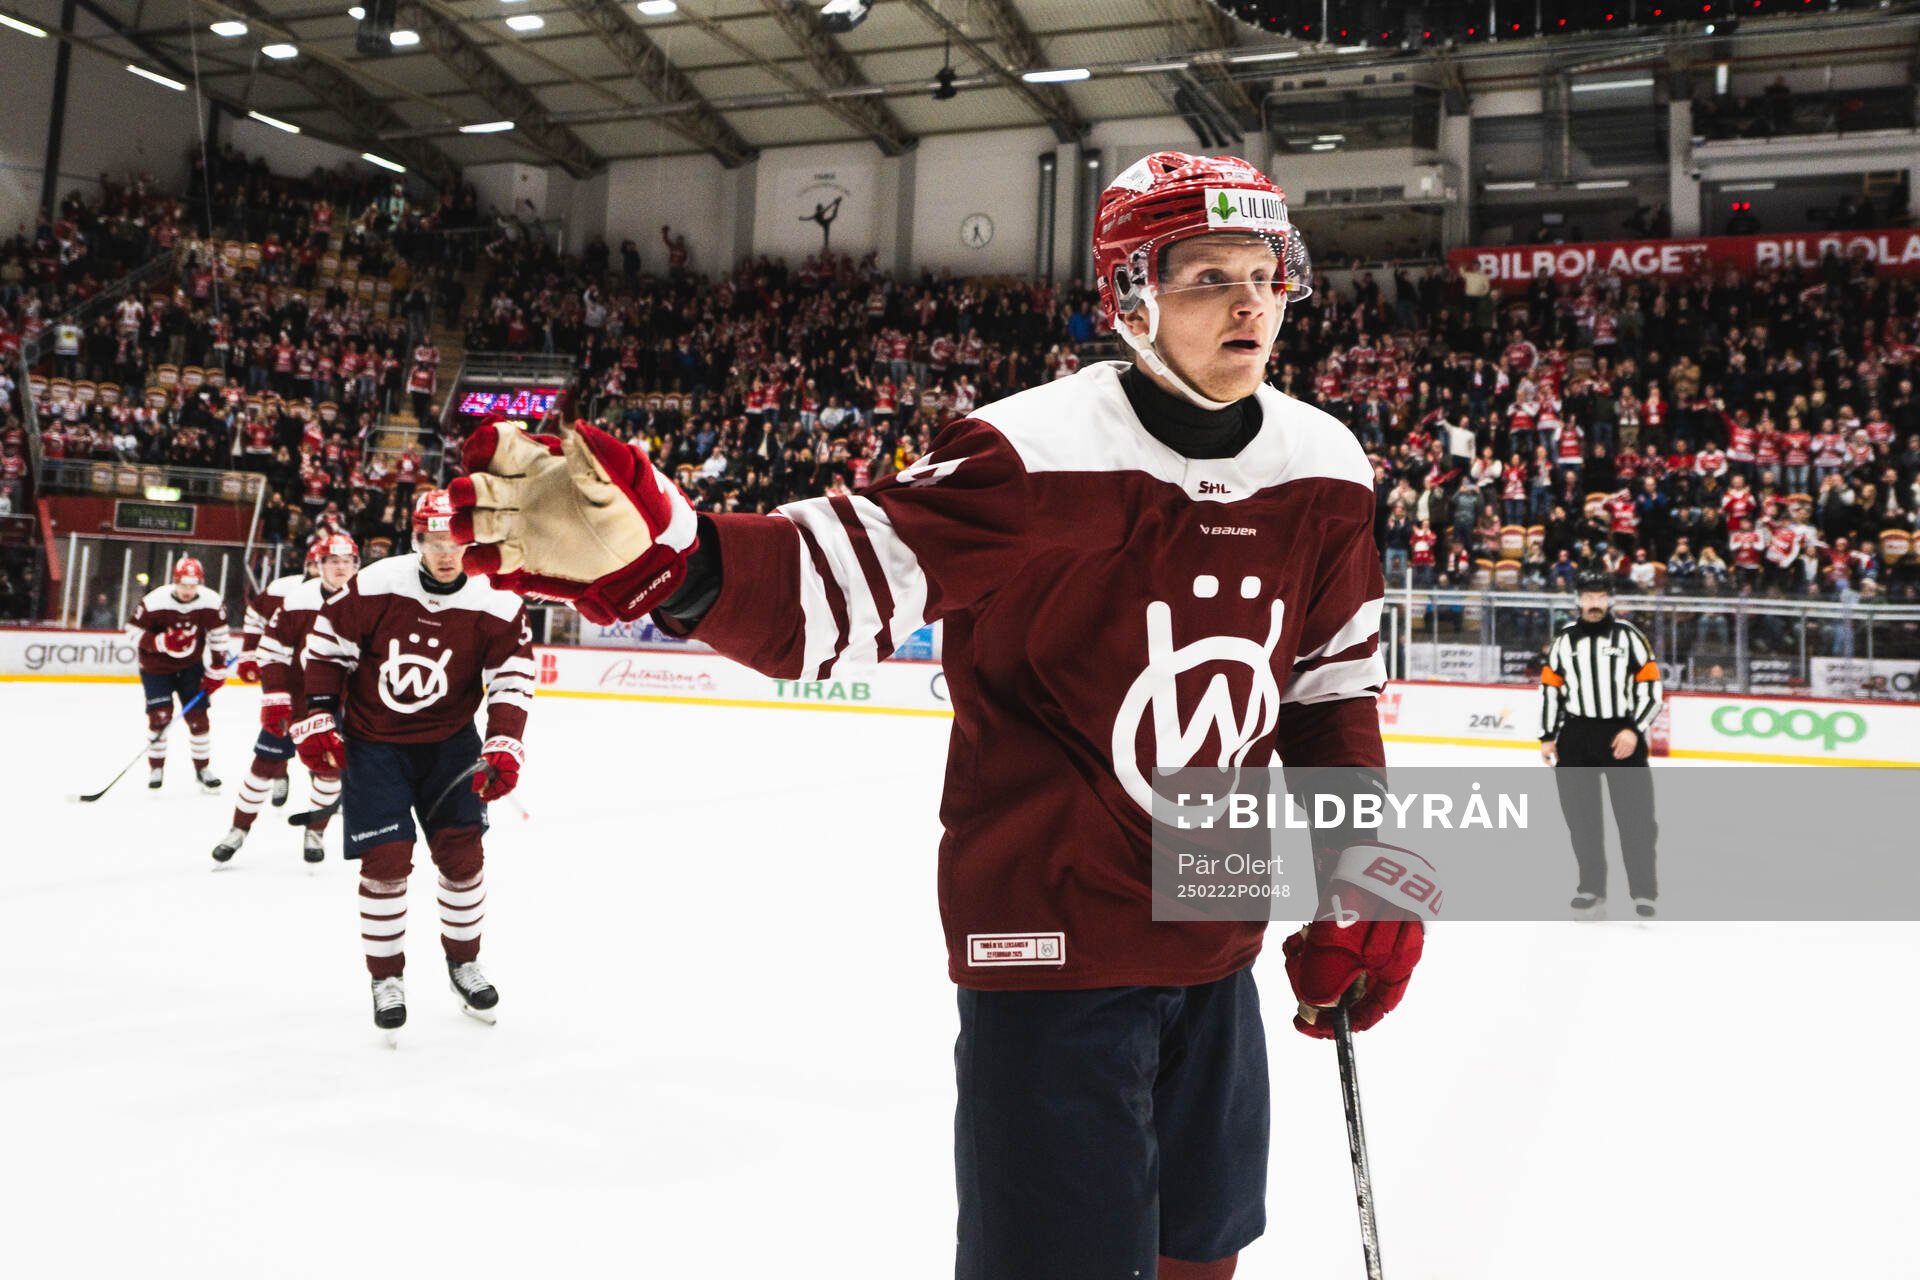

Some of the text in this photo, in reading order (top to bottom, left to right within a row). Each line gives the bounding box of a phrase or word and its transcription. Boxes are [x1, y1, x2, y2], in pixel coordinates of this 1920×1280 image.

[1477, 245, 1708, 281] BILBOLAGE
[1198, 481, 1232, 494] SHL
[25, 641, 137, 670] granito
[774, 679, 871, 700] TIRAB
[1711, 706, 1868, 751] coop
